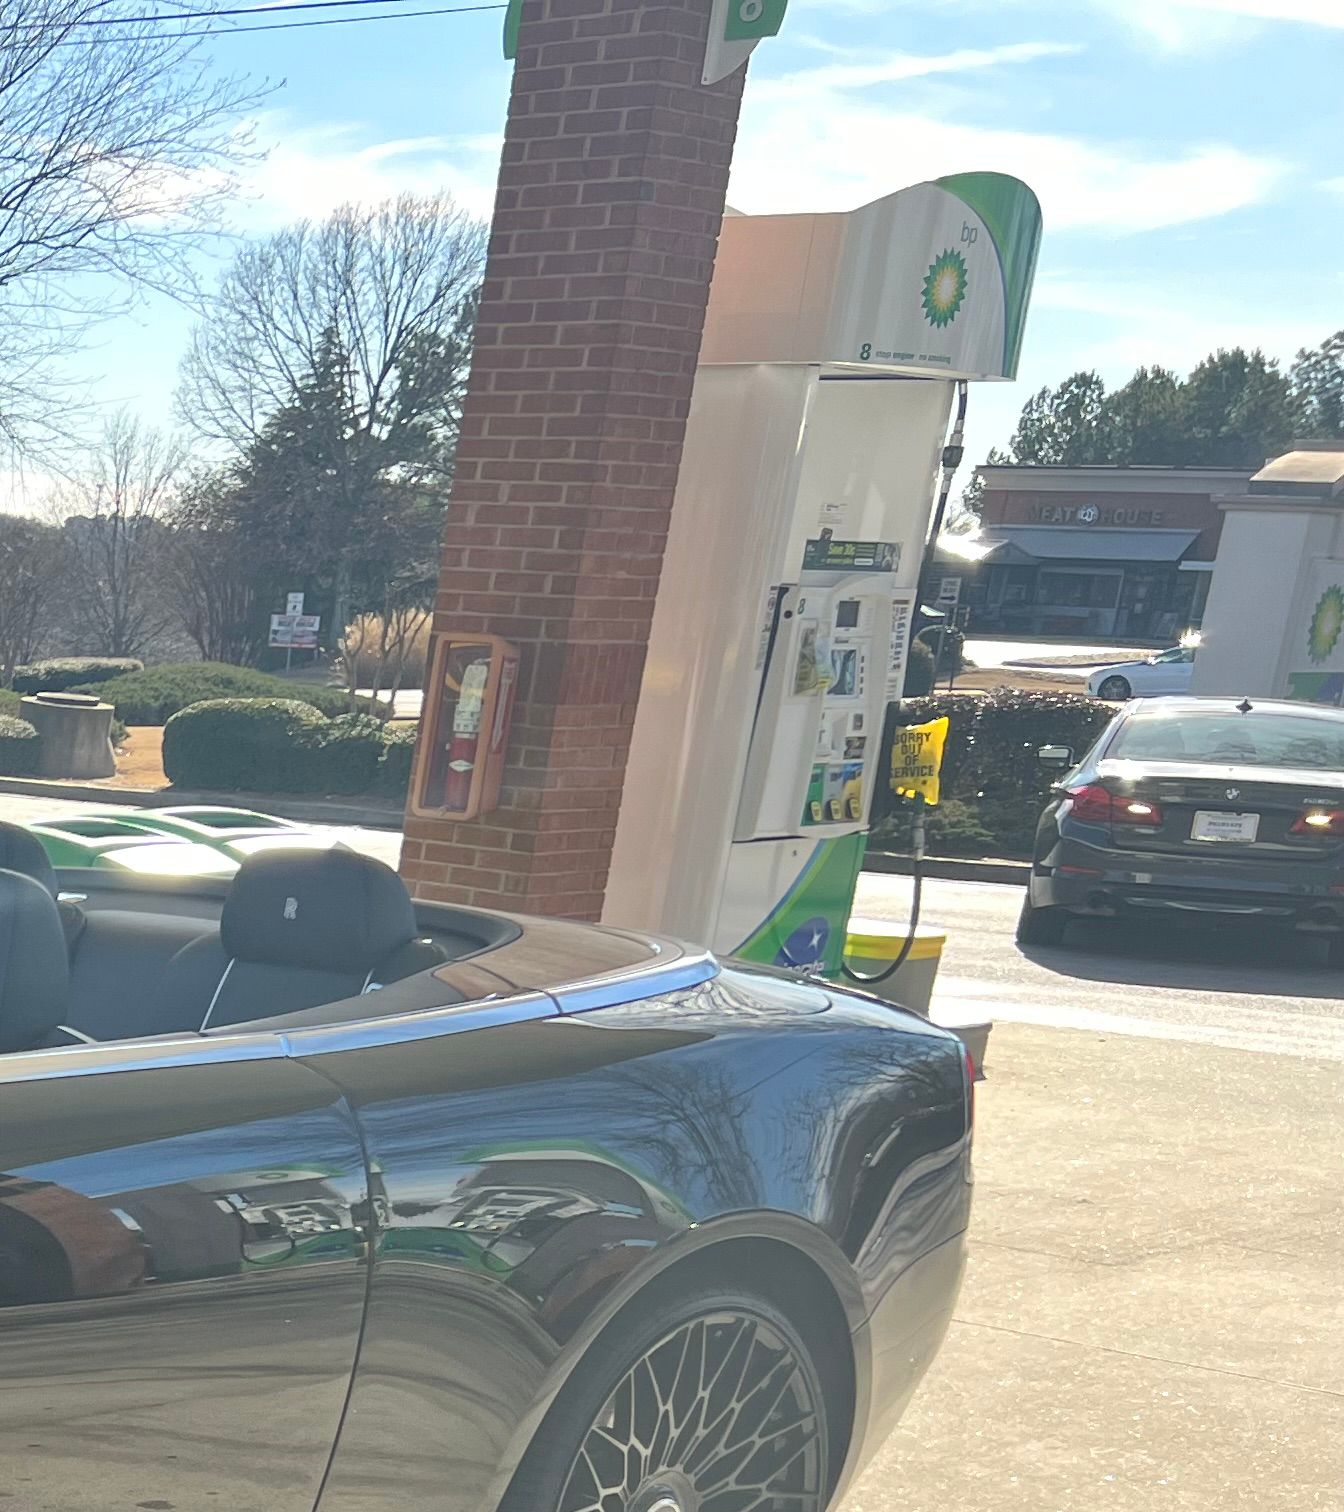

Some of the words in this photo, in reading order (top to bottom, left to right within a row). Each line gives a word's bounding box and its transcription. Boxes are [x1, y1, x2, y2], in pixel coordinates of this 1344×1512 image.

[961, 221, 978, 248] bp
[860, 343, 872, 361] 8
[798, 598, 807, 615] 8
[894, 732, 932, 745] SORRY
[901, 744, 922, 755] OUT
[905, 754, 919, 766] OF
